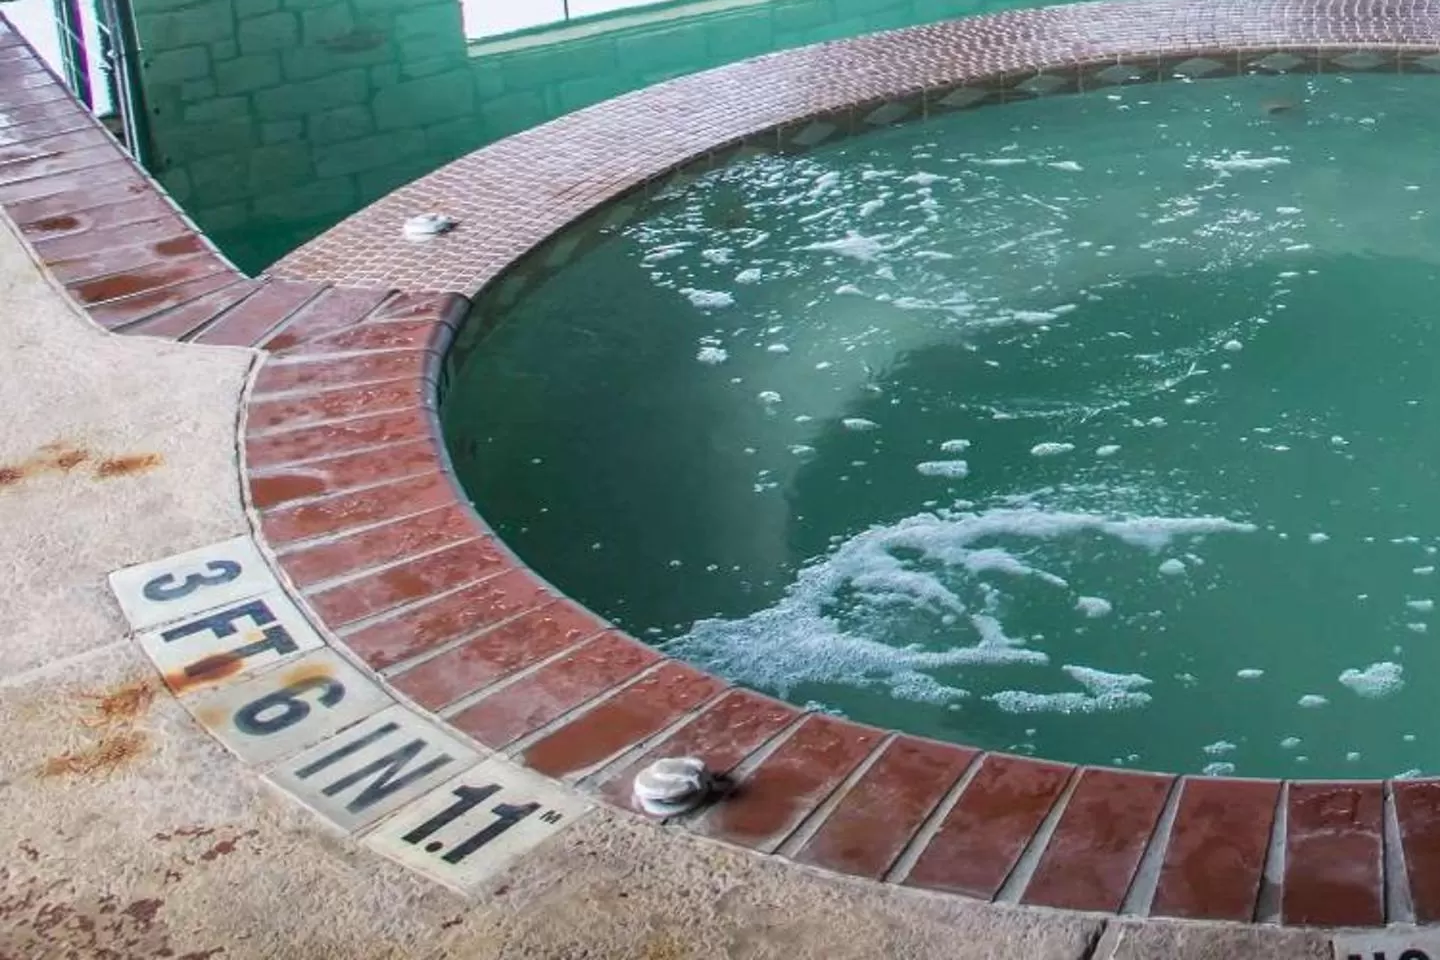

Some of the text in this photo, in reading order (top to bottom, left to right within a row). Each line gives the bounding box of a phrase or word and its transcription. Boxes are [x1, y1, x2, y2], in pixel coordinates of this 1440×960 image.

[142, 559, 242, 603] 3
[160, 598, 300, 677] FT
[232, 674, 346, 736] 6
[293, 721, 456, 815] IN
